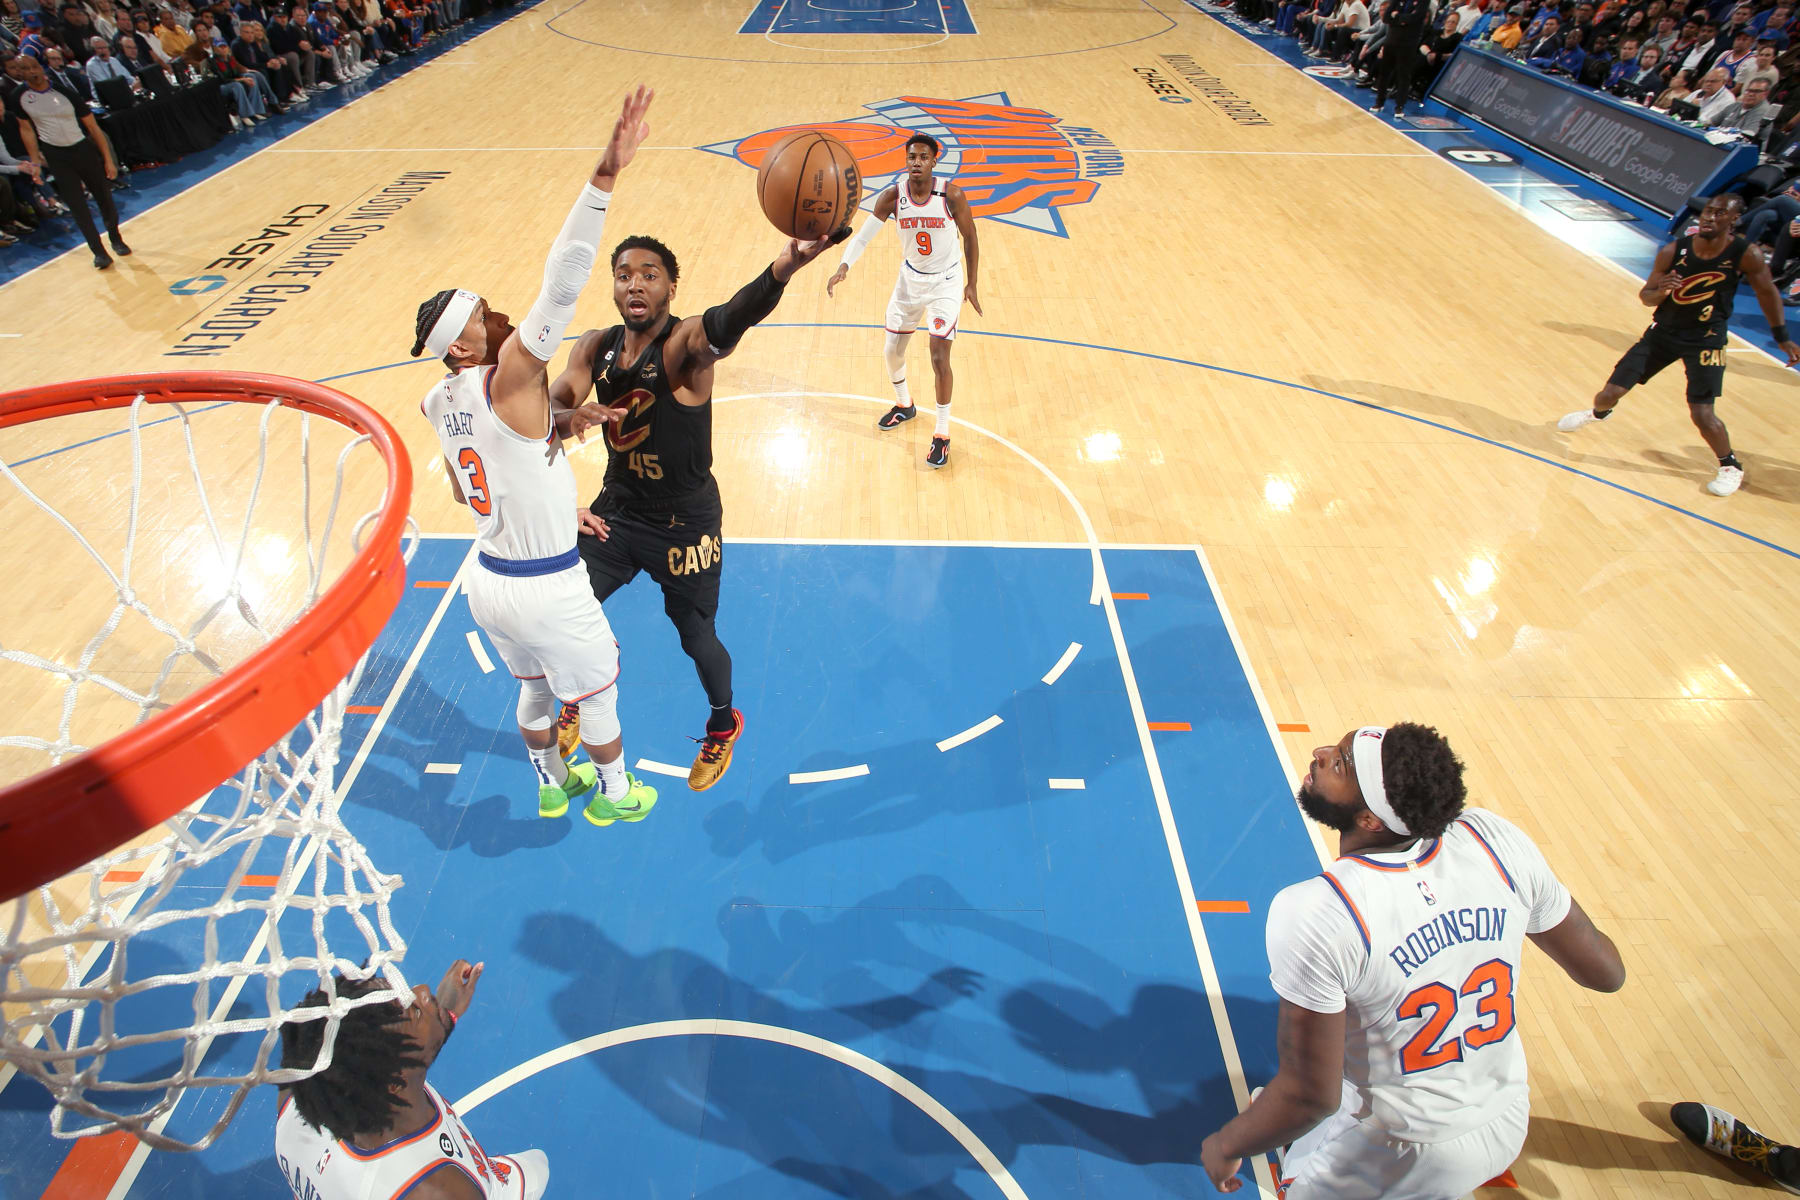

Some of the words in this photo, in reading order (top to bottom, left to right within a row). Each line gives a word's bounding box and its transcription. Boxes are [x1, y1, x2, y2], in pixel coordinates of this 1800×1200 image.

[1132, 67, 1181, 95] CHASE
[1212, 100, 1275, 126] GARDEN
[1058, 125, 1116, 147] NEW
[1559, 110, 1644, 168] PLAYOFFS
[1082, 149, 1125, 178] YORK
[1624, 157, 1664, 184] Google
[1662, 173, 1694, 196] Pixel
[344, 170, 452, 220] MADISON
[204, 203, 331, 271] CHASE
[899, 217, 919, 229] NEW
[919, 217, 945, 229] YORK
[267, 224, 386, 279] SQUARE
[915, 231, 932, 256] 9
[1671, 271, 1727, 305] C
[161, 283, 312, 357] GARDEN
[1698, 304, 1714, 322] 3
[605, 350, 615, 360] 6
[443, 411, 474, 437] HART
[608, 387, 657, 453] C
[458, 447, 492, 517] 3
[628, 450, 664, 480] 45
[667, 534, 721, 576] CAVS
[1388, 907, 1507, 978] ROBINSON
[1395, 957, 1516, 1076] 23
[279, 1153, 322, 1200] RAN
